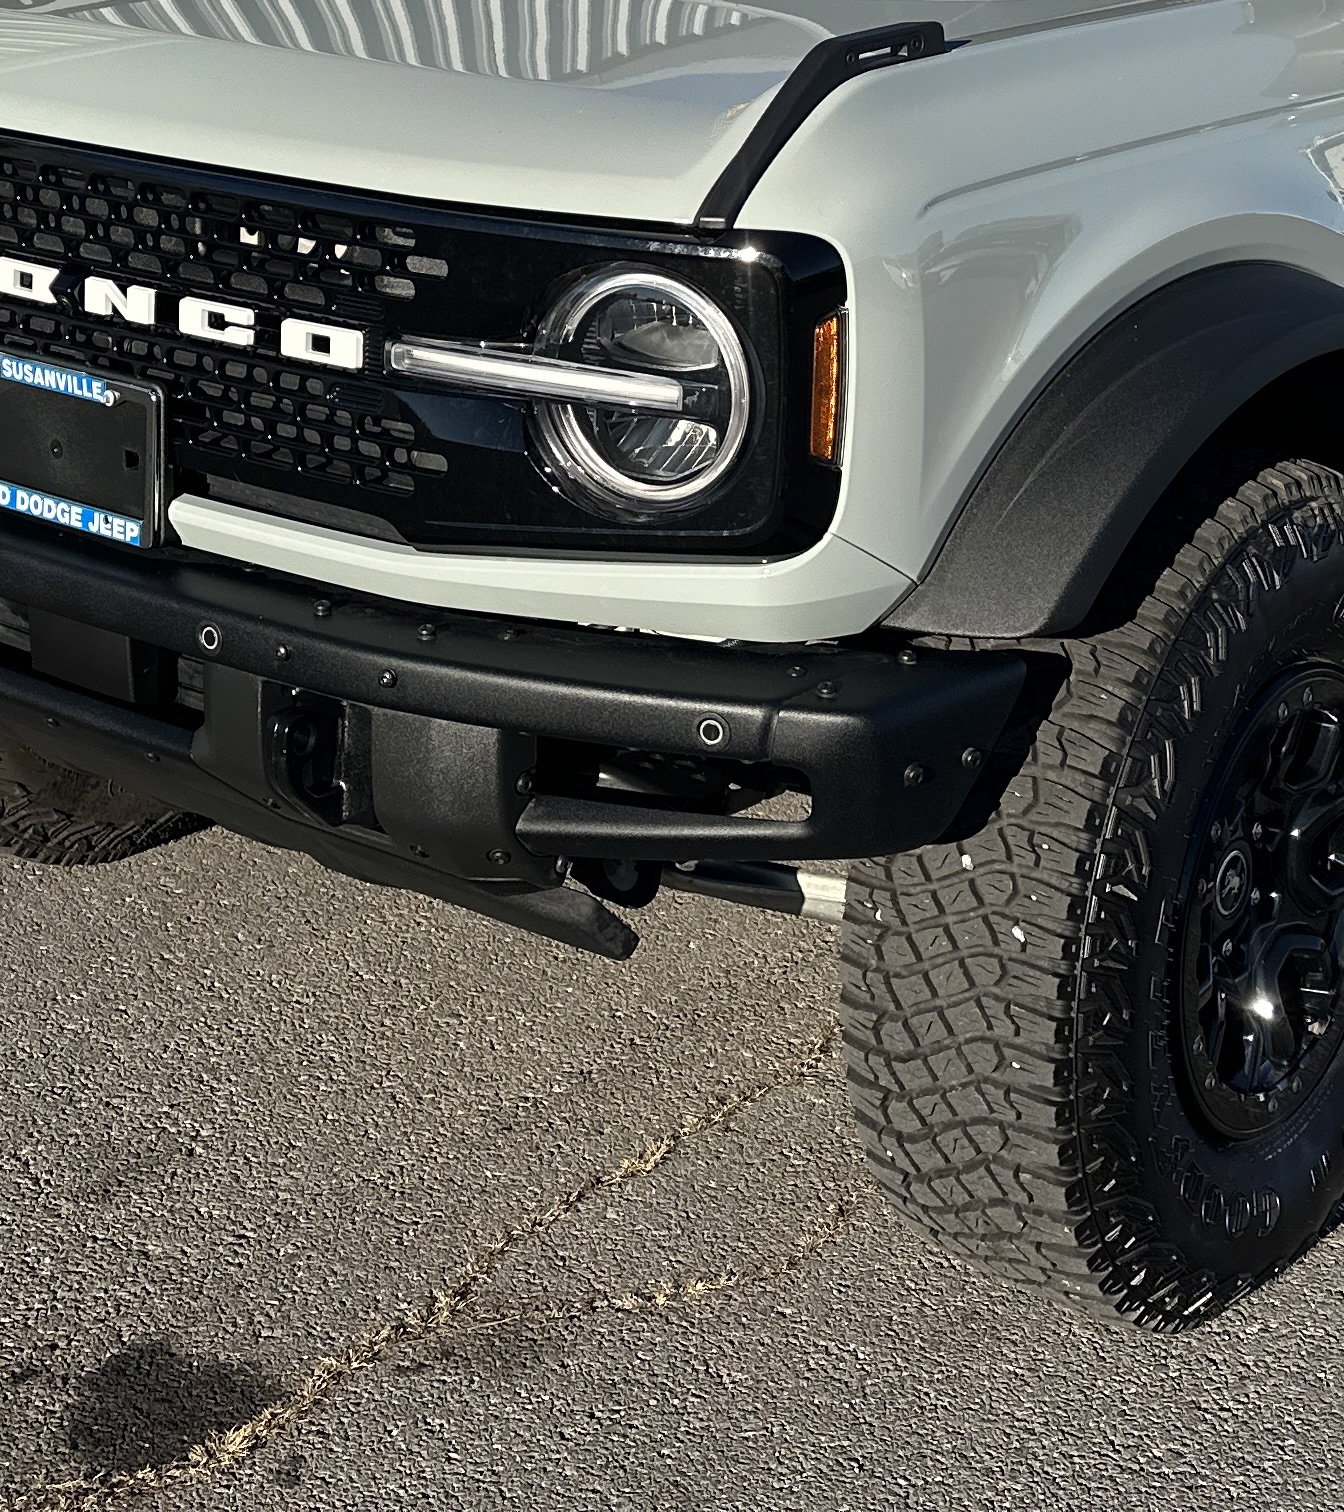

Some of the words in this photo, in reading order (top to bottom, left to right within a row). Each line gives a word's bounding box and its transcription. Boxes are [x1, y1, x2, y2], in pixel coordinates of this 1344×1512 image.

[1, 358, 103, 402] SUSANVILLE
[16, 491, 83, 529] DODGE
[88, 510, 141, 542] JEEP
